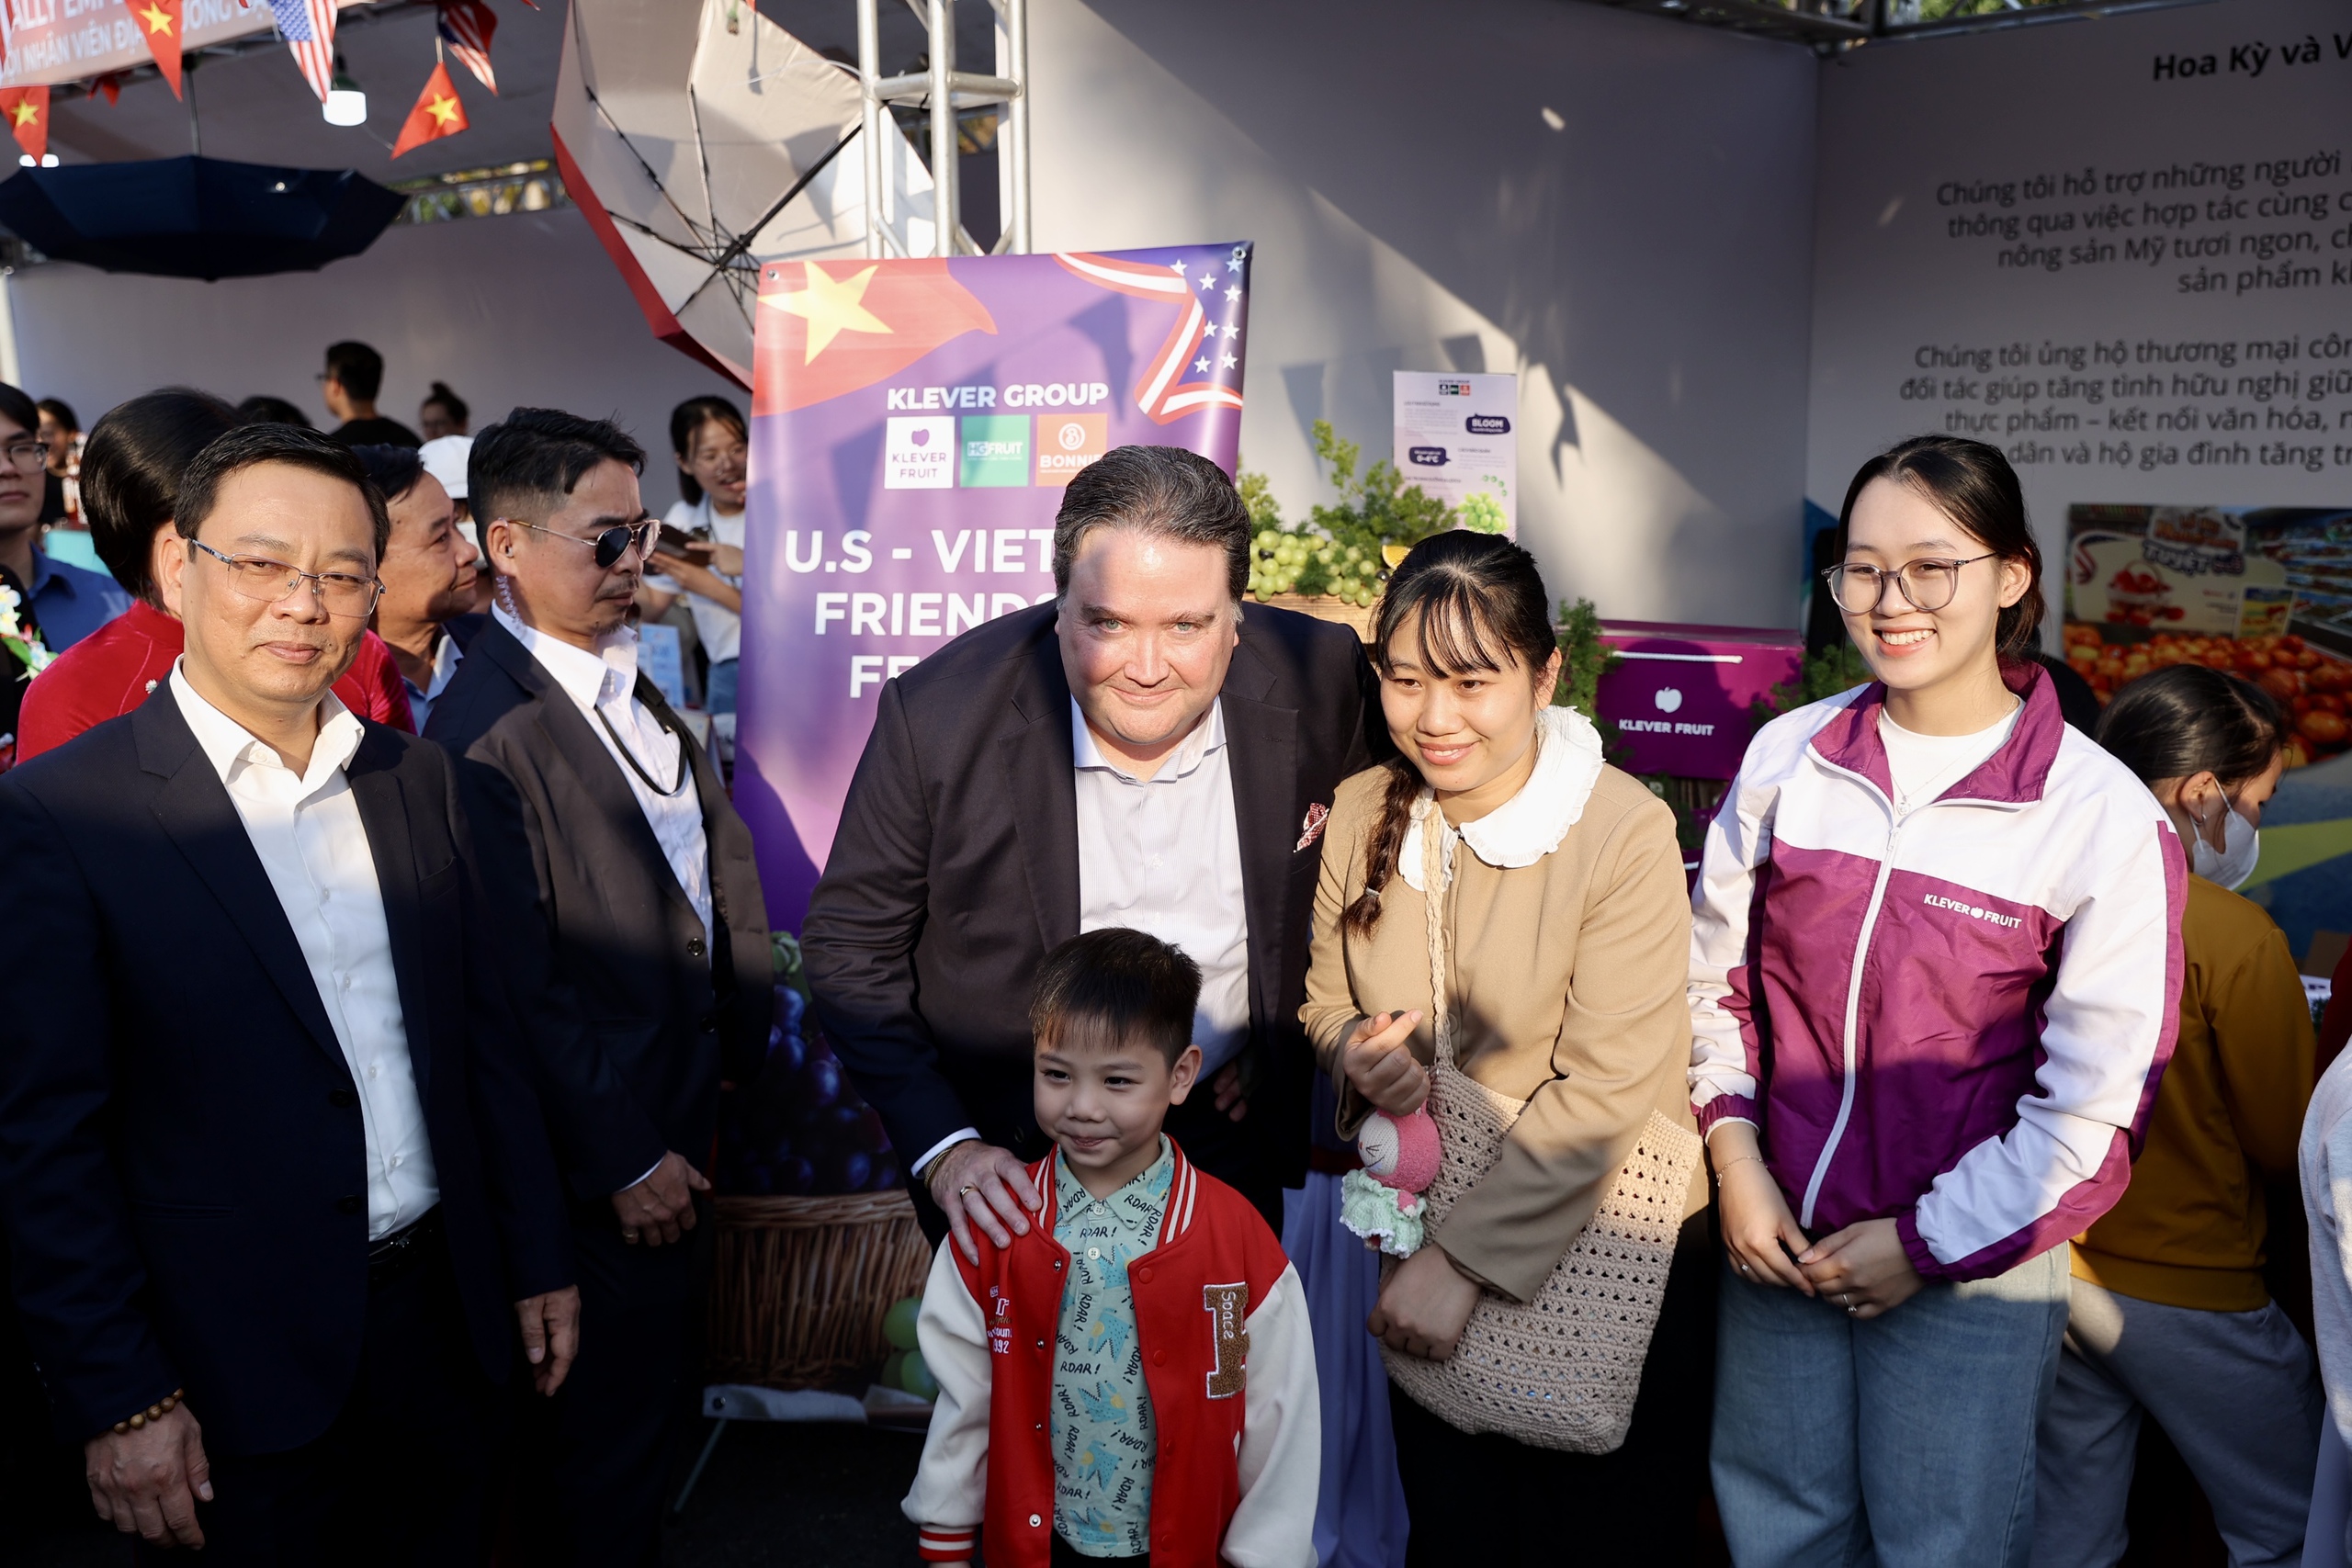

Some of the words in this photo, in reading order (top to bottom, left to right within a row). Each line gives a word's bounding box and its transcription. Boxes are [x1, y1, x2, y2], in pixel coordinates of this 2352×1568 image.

[2153, 53, 2218, 81] Hoa
[2229, 40, 2271, 78] Kỳ
[2280, 34, 2321, 66] và
[1936, 178, 2016, 209] Chúng
[2023, 174, 2056, 199] tôi
[2105, 170, 2146, 197] trợ
[2153, 162, 2245, 190] những
[2255, 150, 2341, 187] người
[1948, 211, 2020, 241] thông
[2027, 211, 2076, 239] qua
[2082, 203, 2135, 231] việc
[2143, 201, 2198, 229] hợp
[2207, 194, 2249, 220] tác
[2257, 189, 2329, 220] cùng
[1997, 243, 2063, 272] nông
[2069, 237, 2117, 265] sản
[2124, 235, 2166, 266] Mỹ
[2174, 231, 2232, 258] tươi
[2240, 231, 2320, 260] ngon,
[2177, 265, 2227, 293] sản
[2236, 258, 2321, 297] phẩm
[1915, 344, 1993, 374] Chúng
[1998, 342, 2031, 367] tôi
[2093, 339, 2128, 368] hộ
[2136, 339, 2237, 368] thương
[2246, 333, 2301, 365] mại
[888, 386, 997, 411] KLEVER
[1003, 382, 1109, 408] GROUP
[1943, 376, 1980, 400] tác
[1984, 375, 2041, 406] giúp
[2047, 375, 2105, 405] tăng
[2110, 372, 2164, 398] tình
[2171, 371, 2229, 397] hữu
[2237, 369, 2301, 402] nghị
[1945, 408, 1999, 434] thực
[2007, 404, 2080, 437] phẩm
[2109, 404, 2148, 432] kết
[2156, 404, 2199, 432] nối
[2206, 407, 2257, 432] văn
[2267, 404, 2328, 434] hóa,
[892, 453, 946, 463] KLEVER
[899, 468, 937, 478] FRUIT
[2061, 439, 2091, 465] và
[2098, 439, 2133, 469] hộ
[2138, 441, 2180, 472] gia
[2187, 439, 2251, 466] đình
[2258, 440, 2324, 472] tăng
[785, 529, 873, 573] U.S
[1619, 718, 1672, 734] KLEVER
[1675, 722, 1714, 736] FRUIT
[1924, 893, 1970, 915] KLEVER
[1984, 910, 2022, 929] FRUIT
[1221, 1291, 1237, 1339] Space
